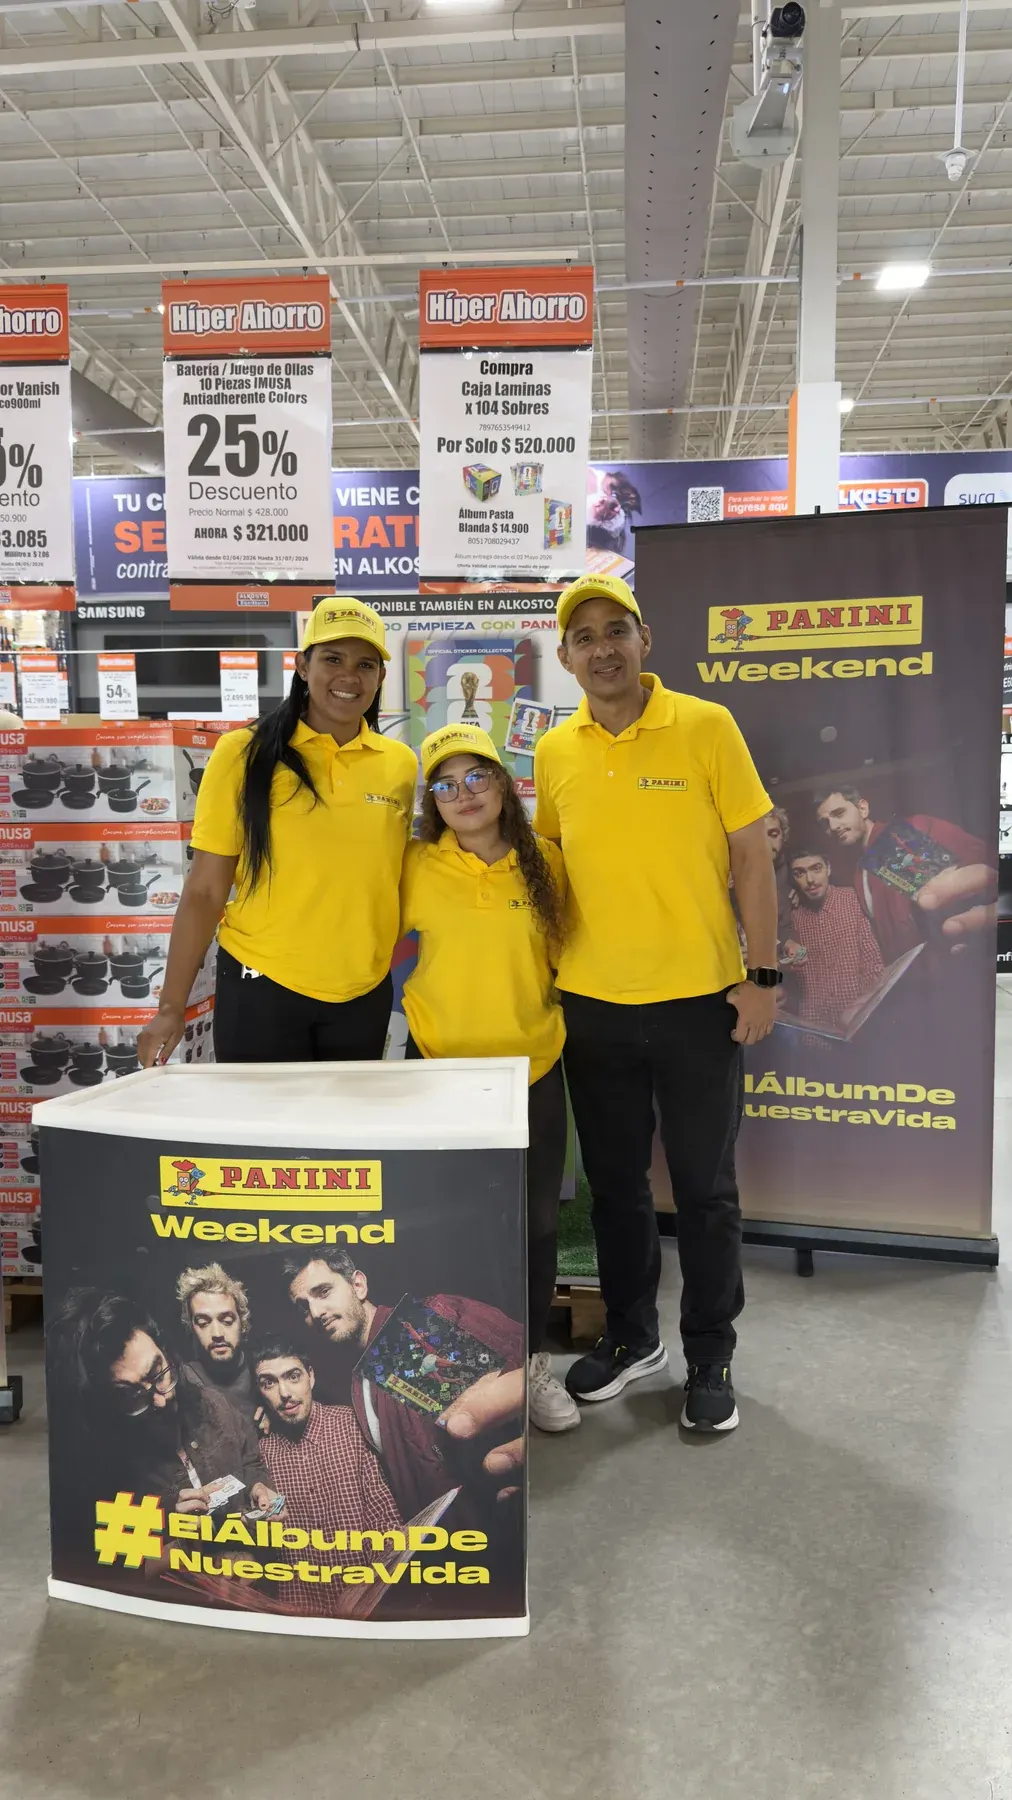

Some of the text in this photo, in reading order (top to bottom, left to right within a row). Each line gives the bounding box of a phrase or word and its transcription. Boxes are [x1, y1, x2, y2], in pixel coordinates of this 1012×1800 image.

[428, 291, 586, 323] Híper Ahorro
[171, 301, 323, 333] Híper Ahorro
[177, 362, 219, 376] Batería
[230, 363, 264, 376] Juego
[267, 363, 281, 376] de
[285, 363, 314, 376] Ollas
[480, 360, 533, 377] Compra
[16, 382, 60, 396] Vanish
[200, 377, 291, 390] 10 Piezas IMUSA
[461, 381, 552, 397] Caja Laminas
[183, 391, 308, 405] Antiadherente Colors
[465, 400, 549, 415] x 104 Sobres
[187, 413, 297, 478] 25%
[437, 436, 576, 454] Por Solo $ 520.000
[189, 481, 298, 500] Descuento
[336, 486, 400, 506] VIENE
[959, 491, 995, 504] sura
[113, 493, 141, 512] TU
[728, 502, 767, 514] ingresa
[189, 507, 289, 517] Precio Normal $ 428.000
[458, 507, 514, 520] Álbum Pasta
[114, 520, 167, 553] SE
[194, 524, 309, 542] AHORA $ 321.000
[458, 522, 529, 534] Blanda $ 14.900
[0, 529, 48, 548] 3.085
[78, 606, 146, 619] SAMSUNG
[420, 599, 473, 612] TAMBIÉN
[478, 600, 493, 611] EN
[497, 599, 557, 611] ALKOSTO.
[408, 621, 475, 631] EMPIEZA
[481, 621, 515, 630] CON
[766, 603, 912, 631] PANINI
[697, 652, 933, 683] Weekend
[652, 779, 685, 787] PANINI
[742, 1103, 956, 1130] uestraVida
[220, 1166, 371, 1190] PANINI
[150, 1213, 395, 1244] Weekend
[168, 1512, 488, 1552] ElÁlbumDe
[169, 1548, 490, 1584] NuestraVida
